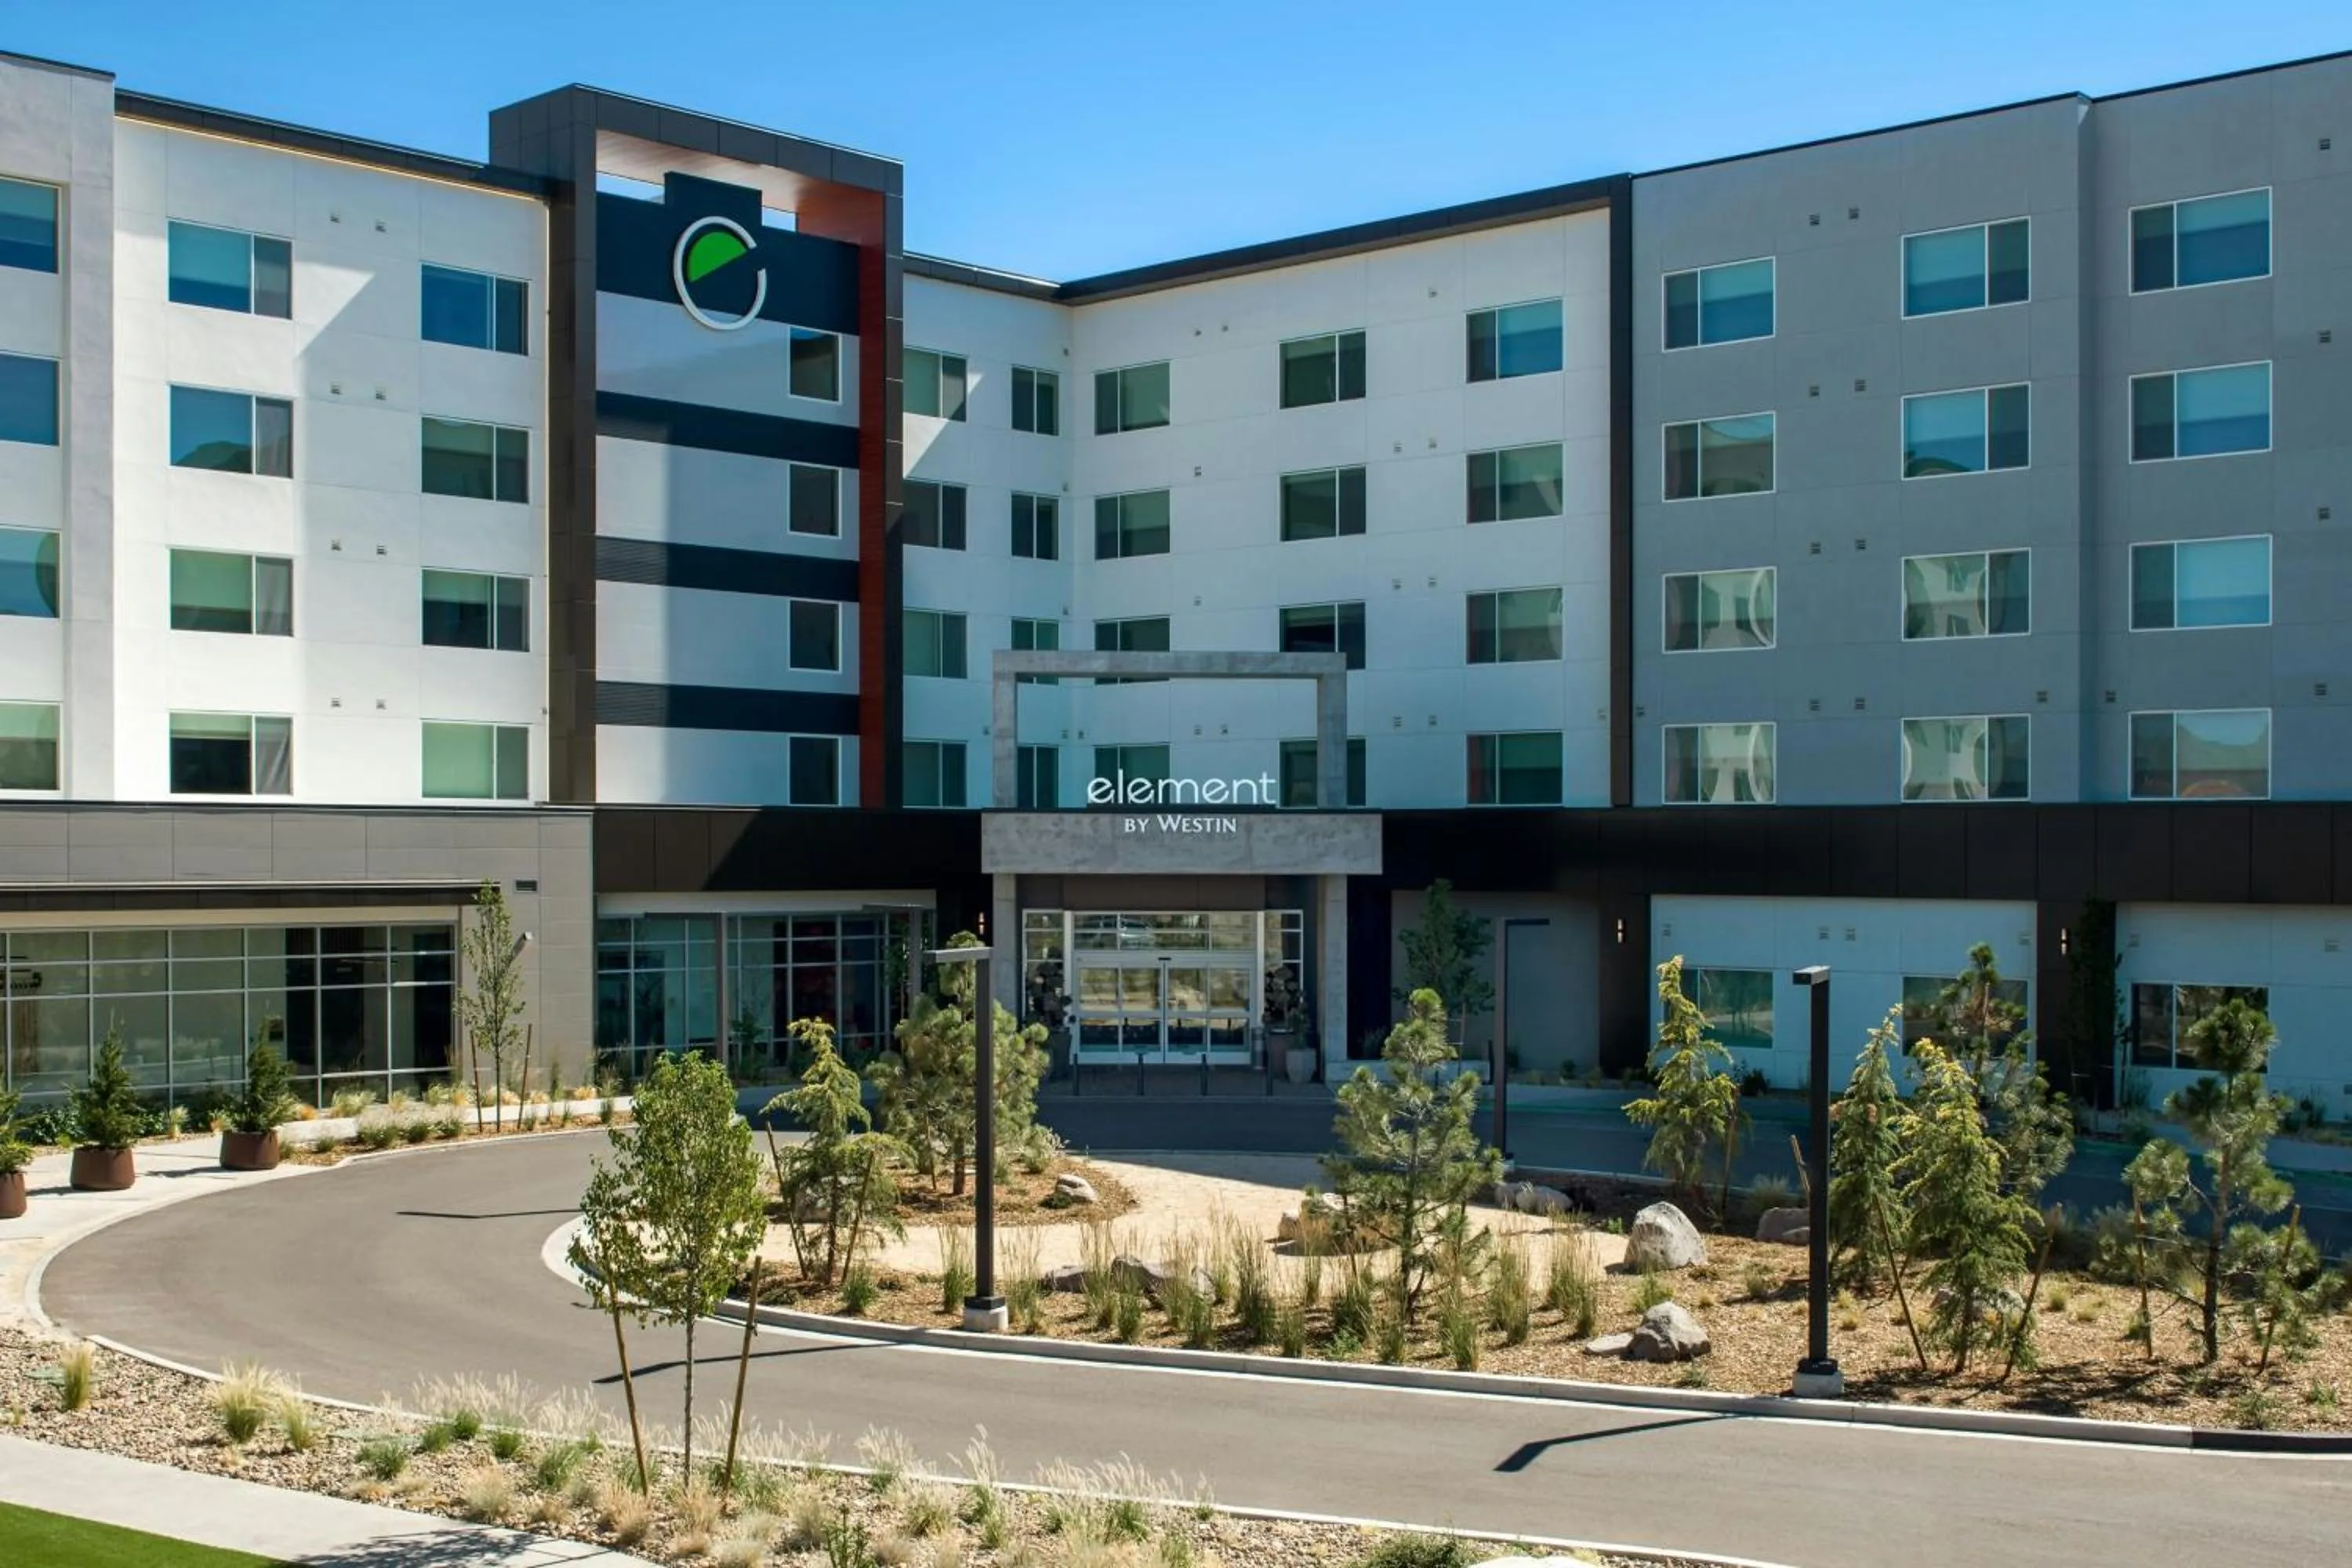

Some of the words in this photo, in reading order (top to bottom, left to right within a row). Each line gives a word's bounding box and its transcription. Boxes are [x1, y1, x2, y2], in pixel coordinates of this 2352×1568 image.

[1087, 768, 1277, 804] element
[1124, 818, 1149, 833] BY
[1156, 815, 1236, 833] WESTIN
